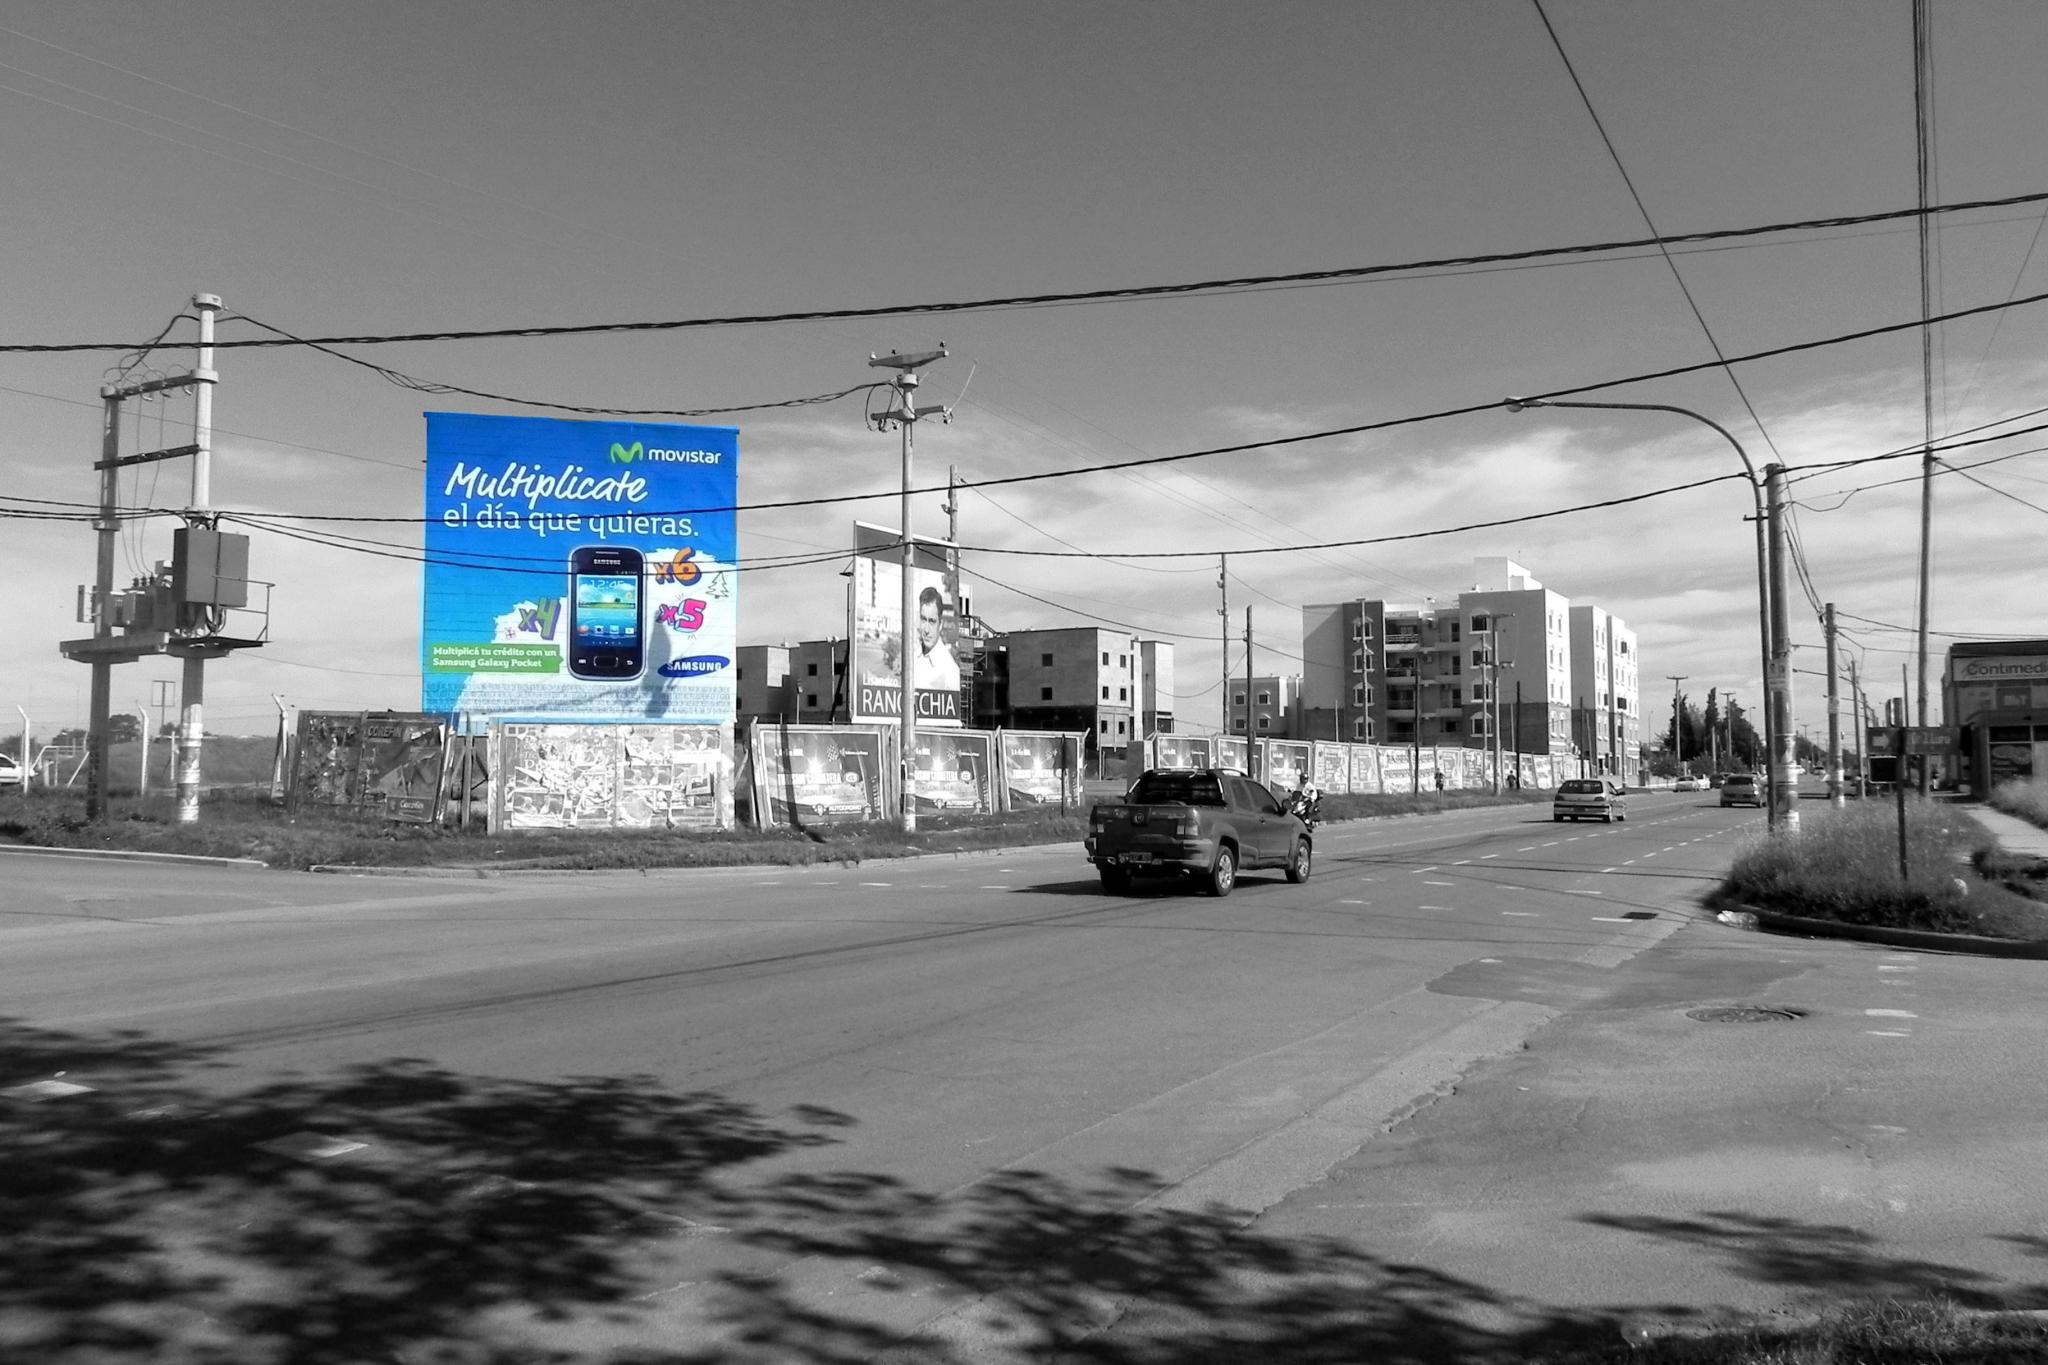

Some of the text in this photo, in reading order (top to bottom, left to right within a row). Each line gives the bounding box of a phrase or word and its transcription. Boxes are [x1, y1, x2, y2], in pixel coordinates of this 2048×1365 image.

[648, 449, 721, 464] movistar
[444, 462, 648, 510] Multiplicate
[443, 502, 699, 539] el día que quieras.
[653, 546, 702, 587] x6
[518, 597, 561, 641] x4
[657, 598, 707, 633] x5
[433, 647, 480, 657] Multiplicá
[481, 647, 489, 656] tu
[492, 647, 525, 657] crédito
[433, 658, 543, 669] Samsung Galaxy Pocket
[667, 661, 722, 672] SAMSUNG
